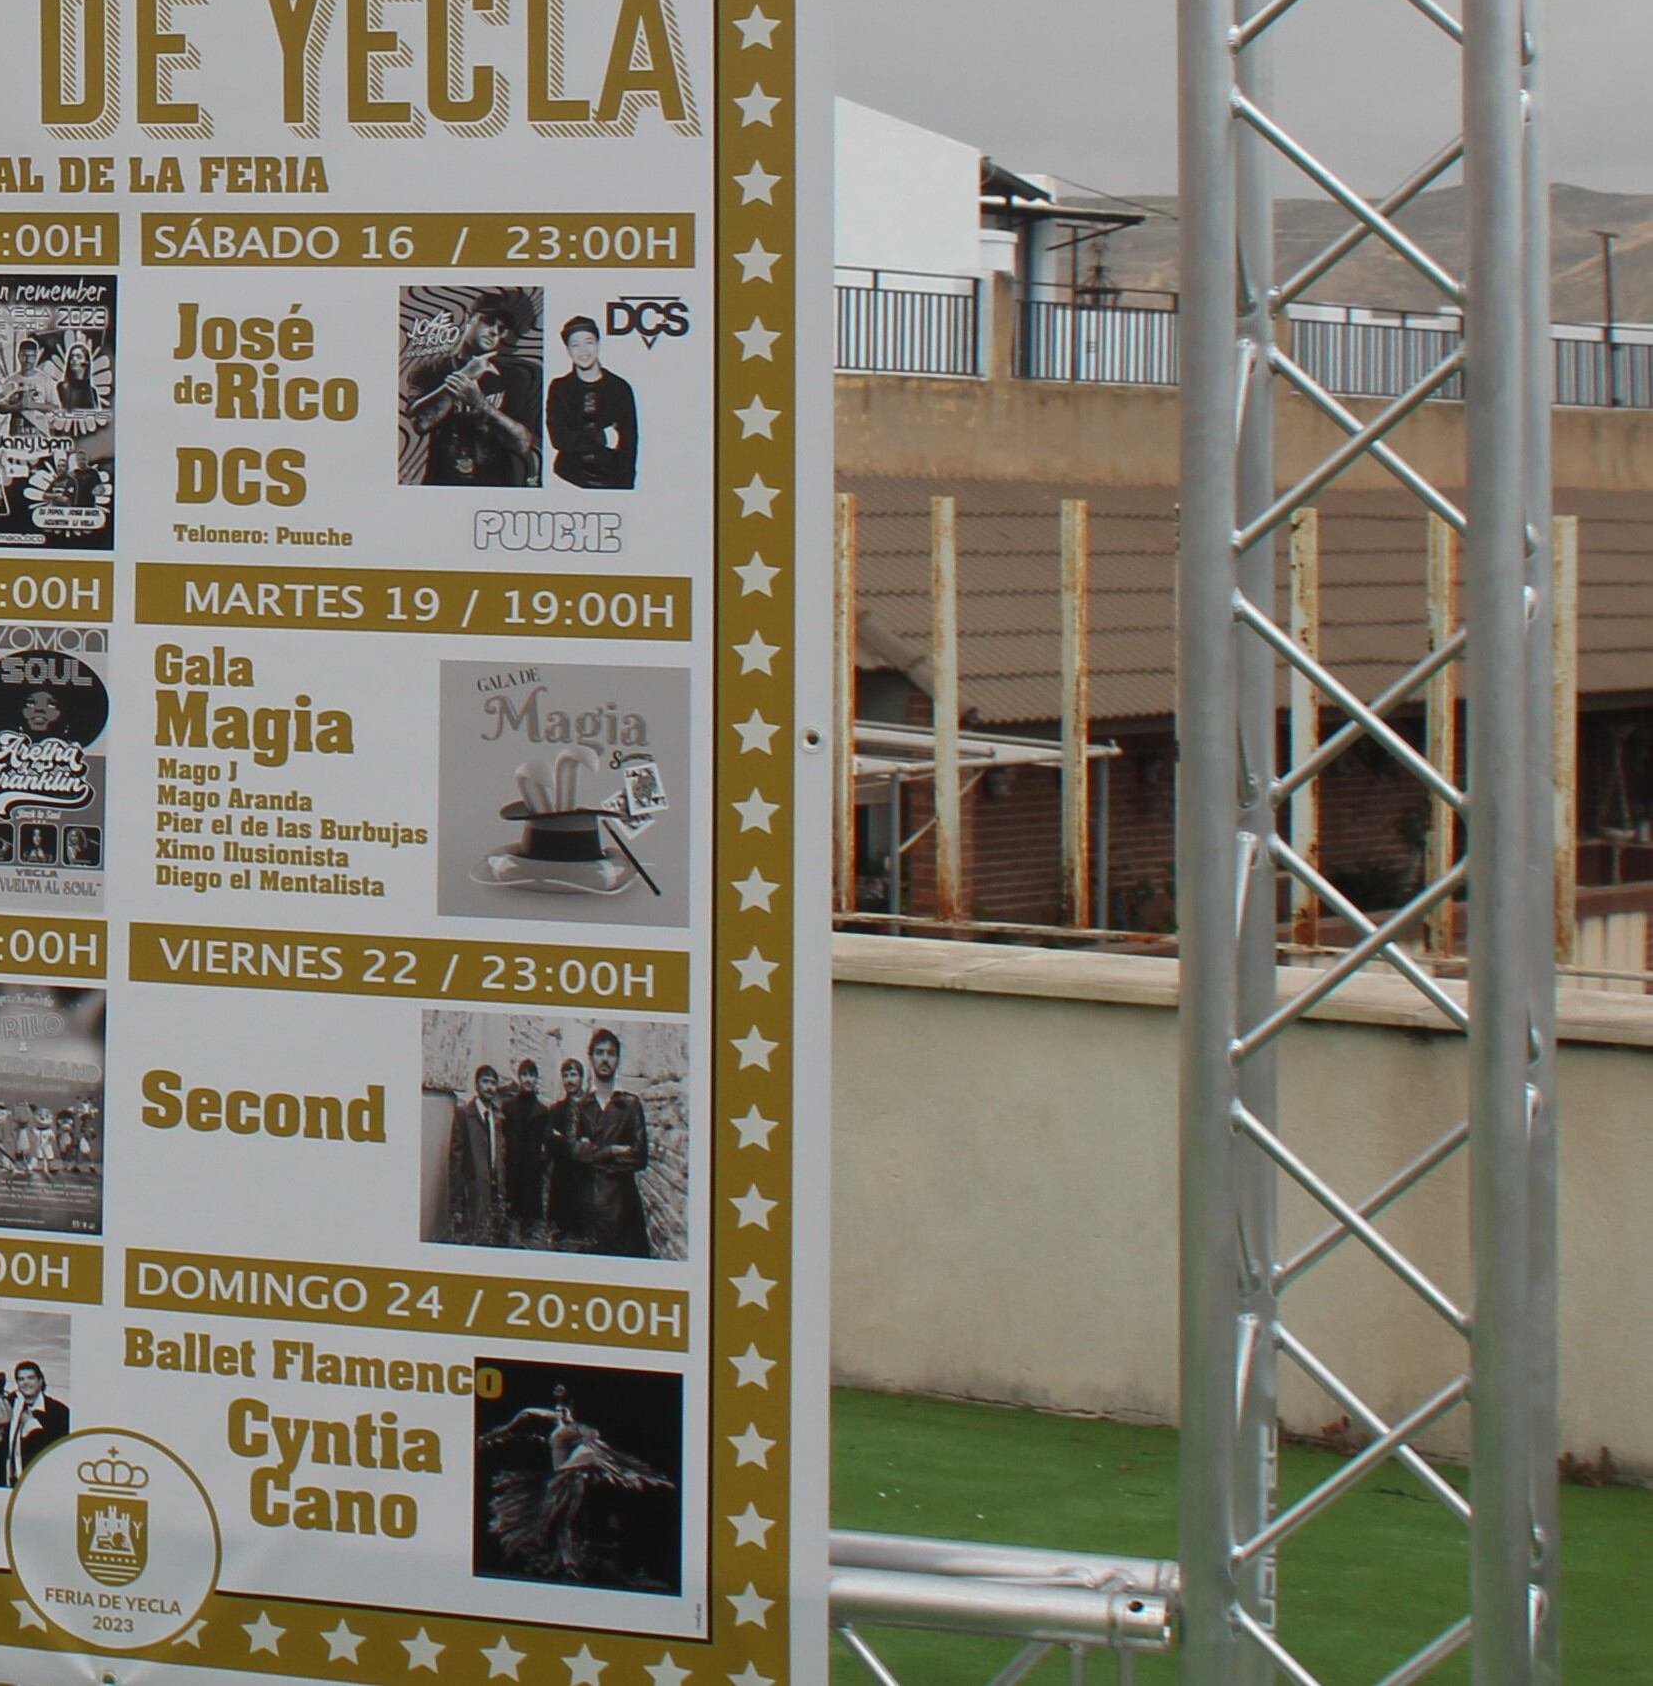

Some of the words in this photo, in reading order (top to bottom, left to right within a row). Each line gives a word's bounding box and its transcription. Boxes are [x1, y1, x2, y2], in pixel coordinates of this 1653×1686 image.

[58, 156, 116, 194] DE
[128, 156, 185, 194] LA
[198, 156, 330, 194] FERIA
[153, 218, 342, 261] SÁBADO
[360, 225, 415, 260] 16
[450, 226, 470, 265] /
[504, 225, 678, 261] 23:00H
[15, 277, 107, 303] remember
[57, 307, 107, 328] 2023
[172, 301, 316, 362] José
[606, 300, 690, 337] DCS
[214, 361, 360, 423] Rico
[38, 435, 73, 453] bpm
[175, 446, 308, 508] DCS
[172, 523, 269, 547] Telonero:
[275, 524, 353, 549] Puuche
[473, 509, 622, 553] PUUCHE
[183, 580, 365, 619] MARTES
[386, 586, 441, 623] 19
[460, 589, 480, 629] /
[503, 588, 675, 630] 19:00H
[0, 657, 94, 687] SOUL
[154, 643, 255, 688] Gala
[476, 672, 518, 693] GALA
[519, 666, 541, 685] DE
[154, 688, 355, 768] Magia
[480, 685, 649, 756] Magia
[156, 756, 221, 786] Mago
[228, 760, 238, 782] J
[156, 784, 221, 813] Mago
[227, 787, 313, 813] Aranda
[156, 811, 204, 836] Pier
[211, 815, 234, 837] el
[239, 816, 269, 838] de
[275, 817, 313, 840] las
[319, 819, 429, 850] Burbujas
[155, 837, 215, 862] Ximo
[223, 840, 349, 868] Ilusionista
[0, 877, 42, 894] VUELTA
[44, 879, 60, 896] AL
[15, 868, 59, 880] YECLA
[155, 864, 222, 896] Diego
[230, 868, 252, 891] el
[258, 869, 386, 898] Mentalista
[158, 936, 345, 982] VIERNES
[360, 948, 418, 986] 22
[439, 954, 459, 993] /
[480, 954, 655, 999] 23:00H
[140, 1068, 388, 1145] Second
[137, 1261, 369, 1314] DOMINGO
[386, 1281, 445, 1318] 24
[464, 1288, 485, 1328] /
[506, 1290, 681, 1339] 20:00H
[123, 1326, 257, 1378] Ballet
[271, 1339, 505, 1400] Flamenco
[226, 1397, 444, 1475] Cyntia
[249, 1465, 418, 1541] Cano
[44, 1586, 95, 1608] FERIA
[97, 1593, 122, 1611] DE
[125, 1596, 184, 1616] YECLA
[92, 1616, 135, 1634] 2023
